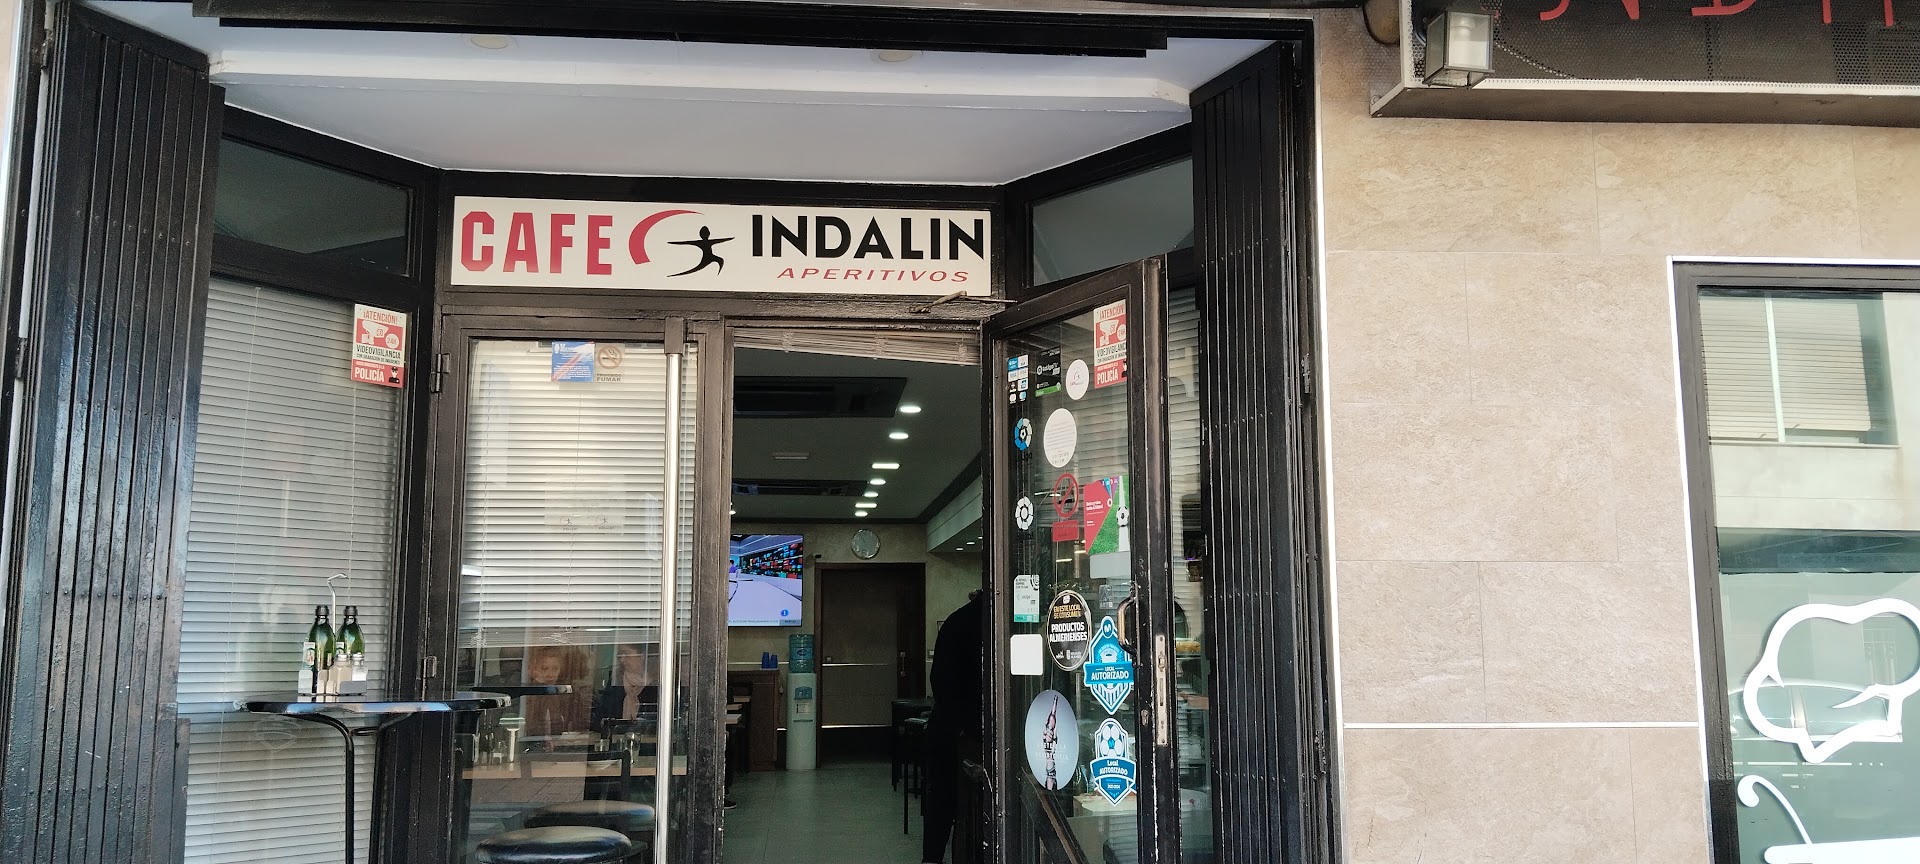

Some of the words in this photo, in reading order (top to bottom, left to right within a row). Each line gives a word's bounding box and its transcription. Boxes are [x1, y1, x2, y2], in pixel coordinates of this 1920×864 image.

[461, 211, 614, 276] CAFE
[752, 214, 984, 261] INDALIN
[777, 267, 970, 283] APERITIVOS
[356, 345, 401, 360] VIDEOVIGILANCIA
[354, 367, 385, 382] POLICÍA
[1097, 367, 1119, 385] POLICÍA
[1068, 604, 1082, 612] LOCAL
[1051, 621, 1085, 633] PRODUCTOS
[1049, 631, 1088, 643] ALMERIENSES
[1091, 670, 1129, 681] AUTORIZADO
[1099, 767, 1128, 776] AUTORIZADO
